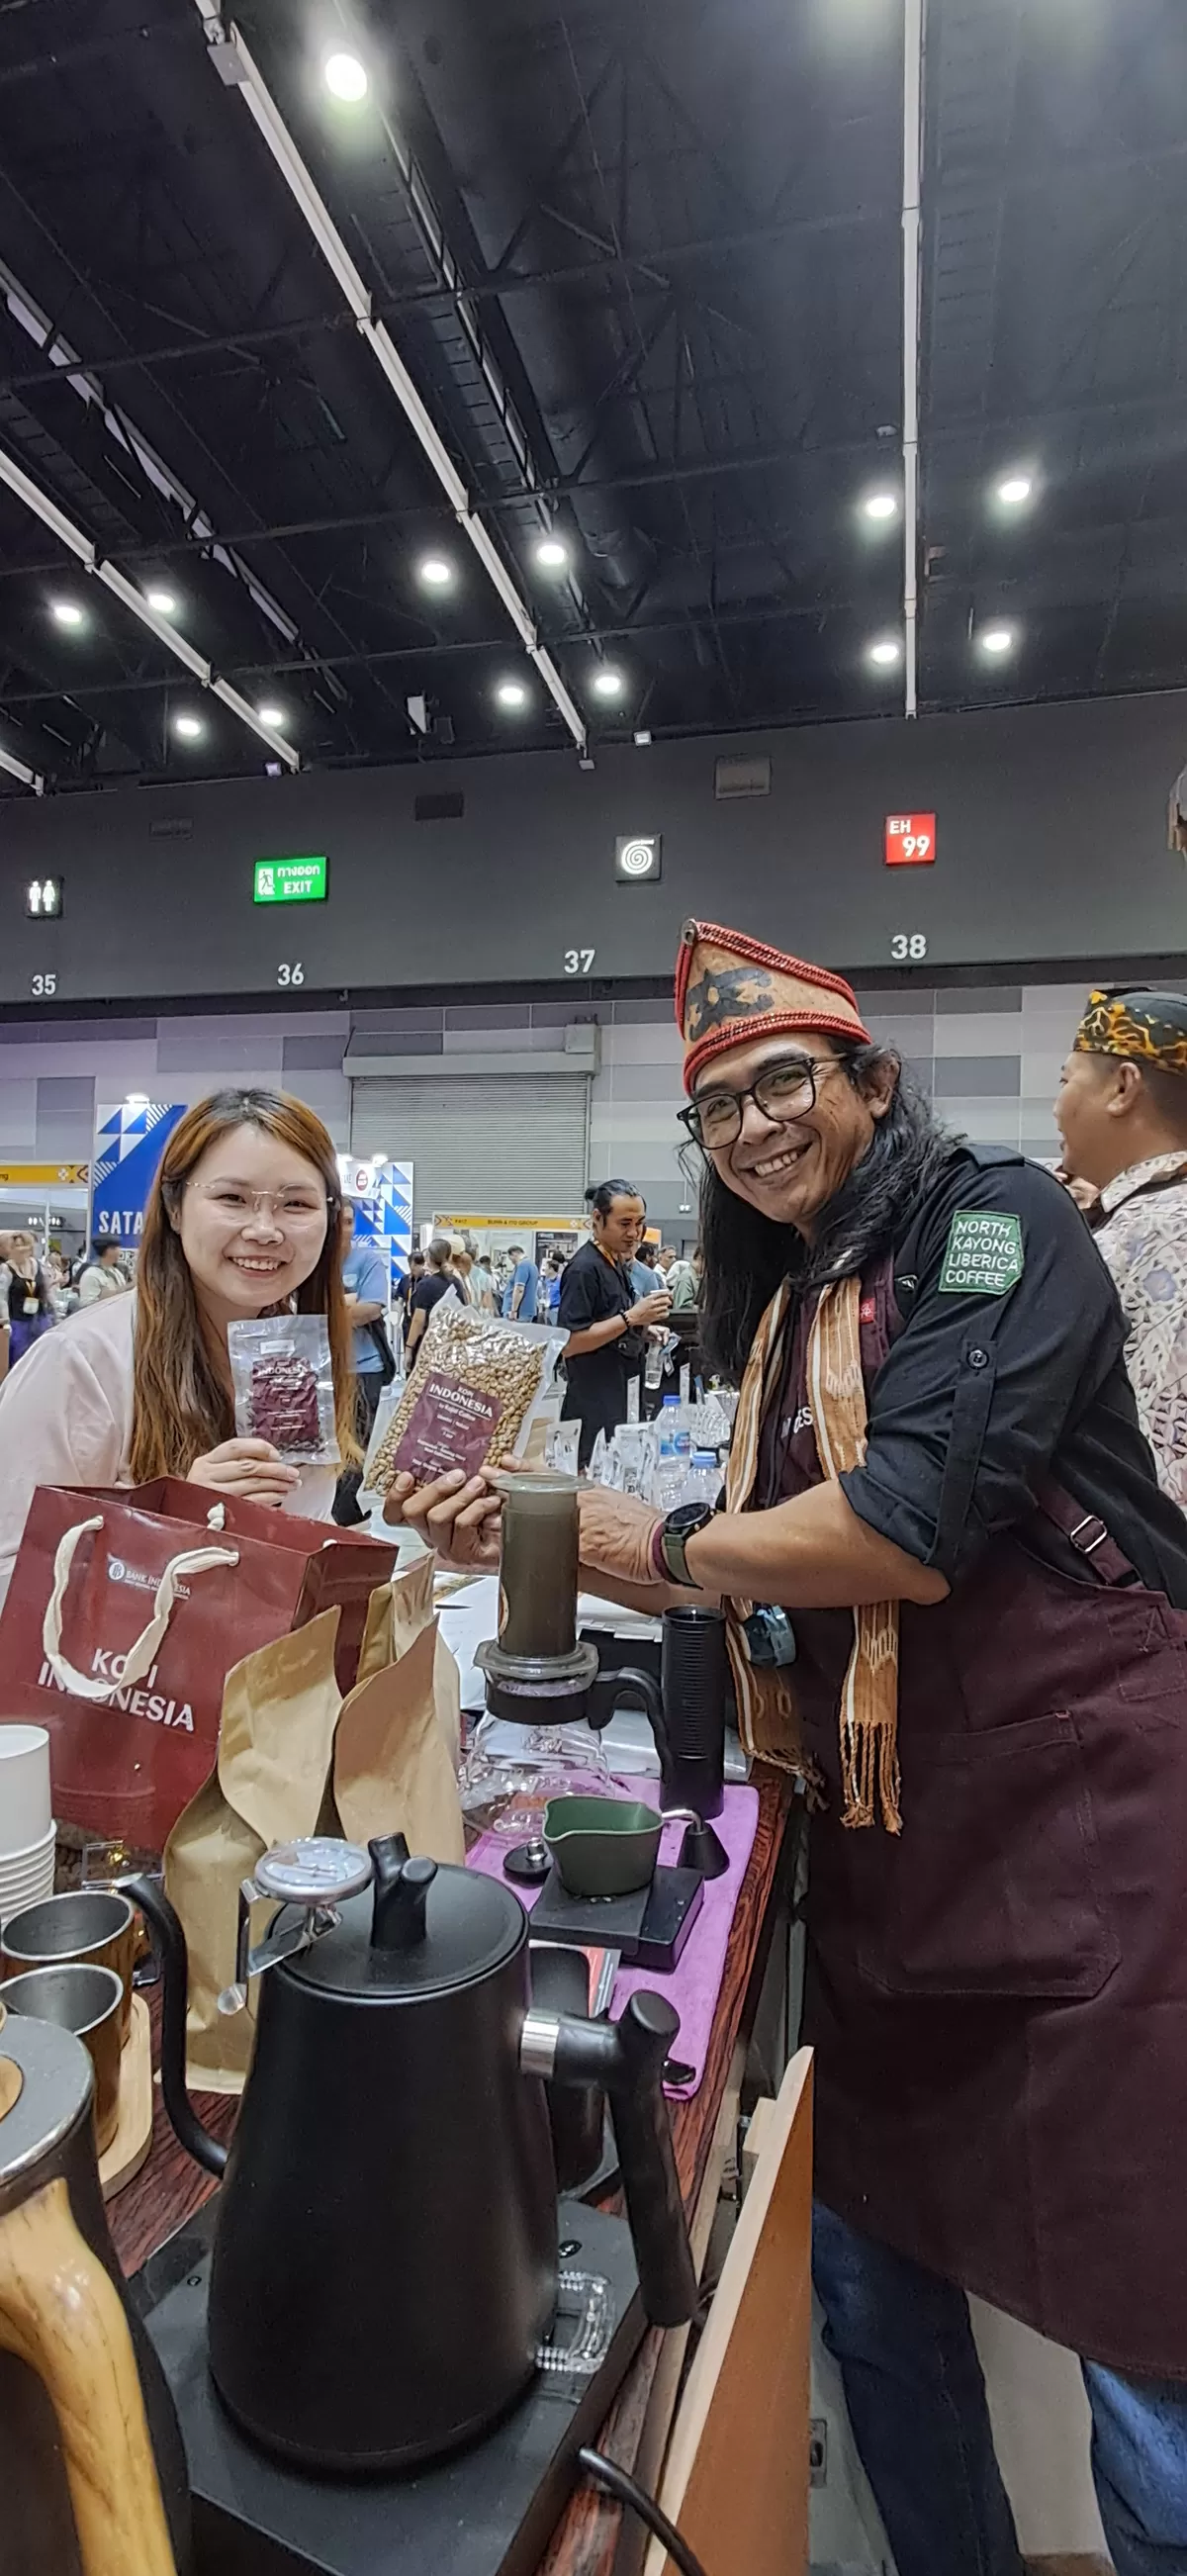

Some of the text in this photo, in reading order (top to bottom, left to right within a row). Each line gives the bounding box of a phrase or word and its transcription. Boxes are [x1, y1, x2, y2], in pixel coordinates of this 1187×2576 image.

[889, 819, 911, 834] EH
[902, 835, 930, 857] 99
[277, 865, 320, 877] ทางออก
[283, 879, 313, 894] EXIT
[890, 934, 927, 960] 38
[564, 949, 595, 973] 37
[32, 973, 56, 995] 35
[277, 963, 305, 985] 36
[956, 1220, 1012, 1238] NORTH
[951, 1236, 1017, 1255] KAYONG
[948, 1252, 1019, 1273] LIBERICA
[945, 1269, 1007, 1287] COFFEE
[429, 1383, 493, 1418] INDONESIA
[126, 1570, 147, 1583] BANK
[91, 1648, 158, 1689] KOI
[38, 1661, 195, 1732] INONESIA
